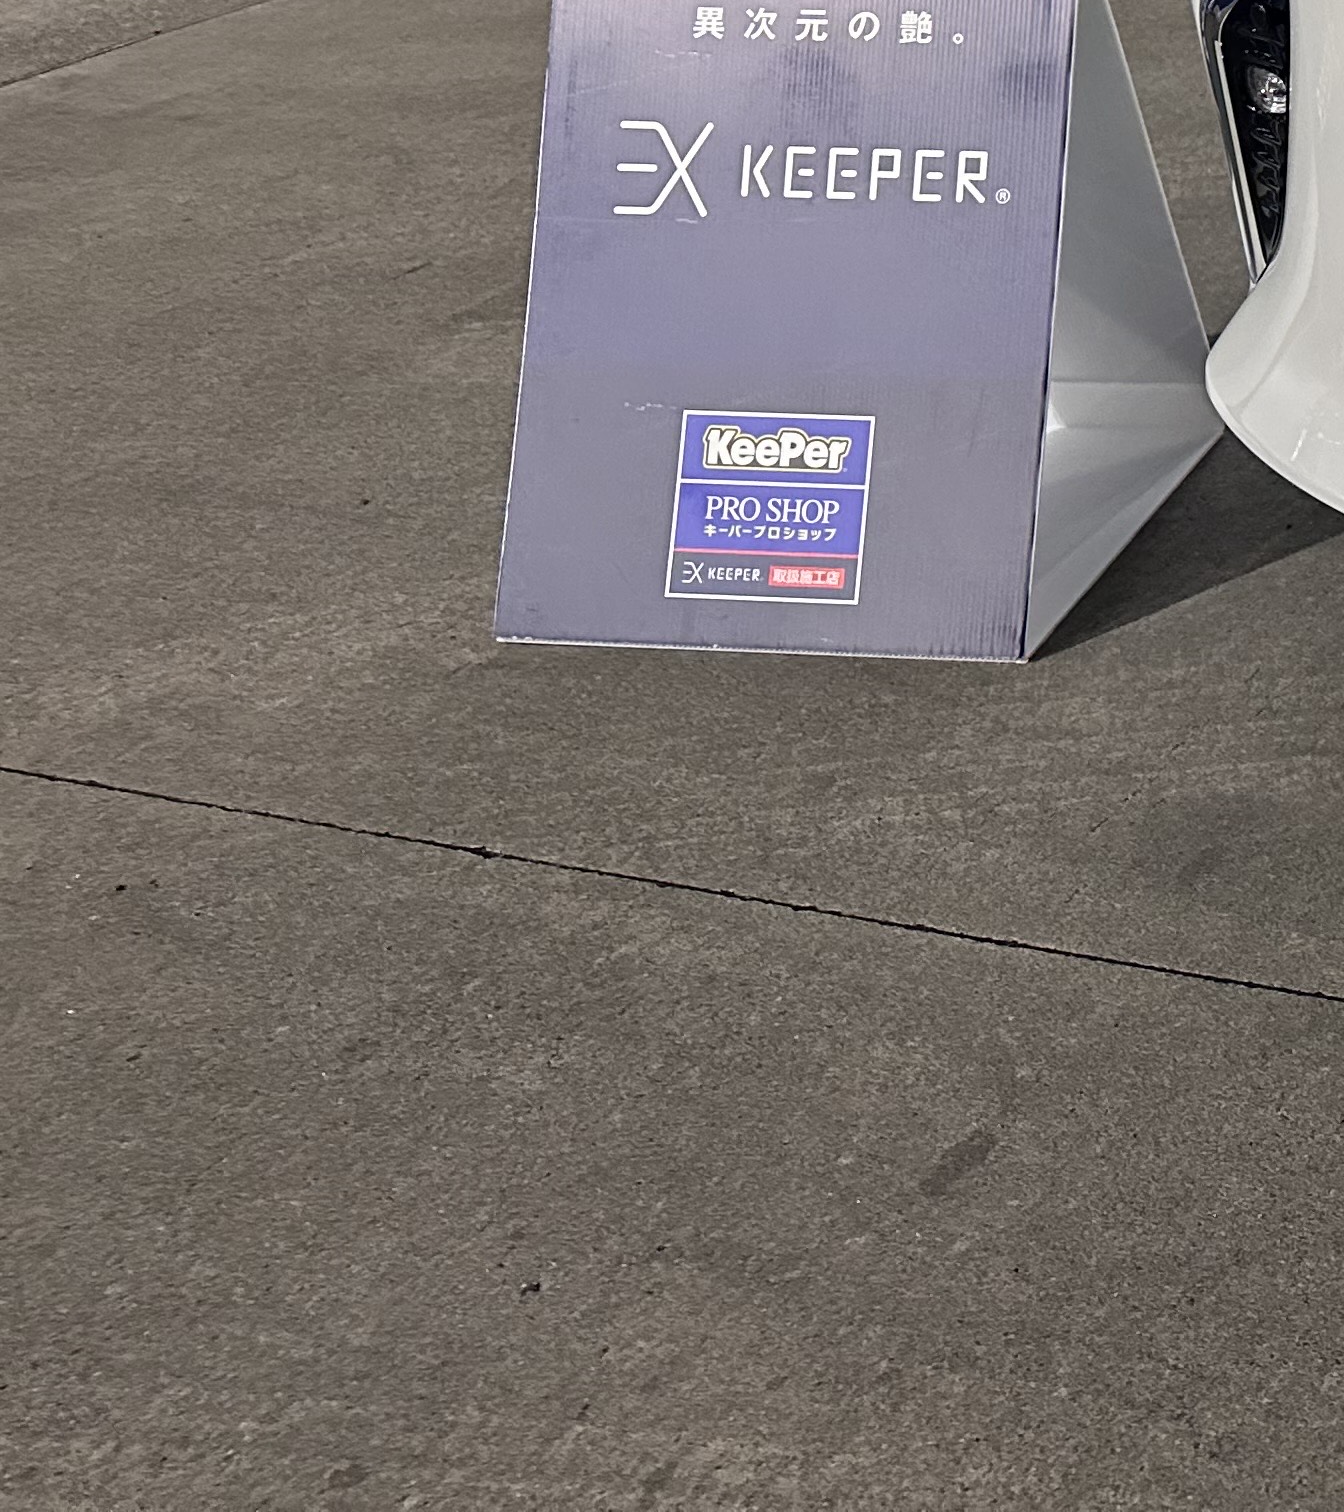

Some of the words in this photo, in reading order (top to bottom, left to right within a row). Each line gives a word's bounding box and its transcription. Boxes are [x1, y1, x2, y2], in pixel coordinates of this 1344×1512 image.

[693, 6, 964, 44] 異次元の艶。
[704, 427, 850, 471] KeePer
[705, 496, 761, 521] PRO
[766, 498, 840, 524] SHOP
